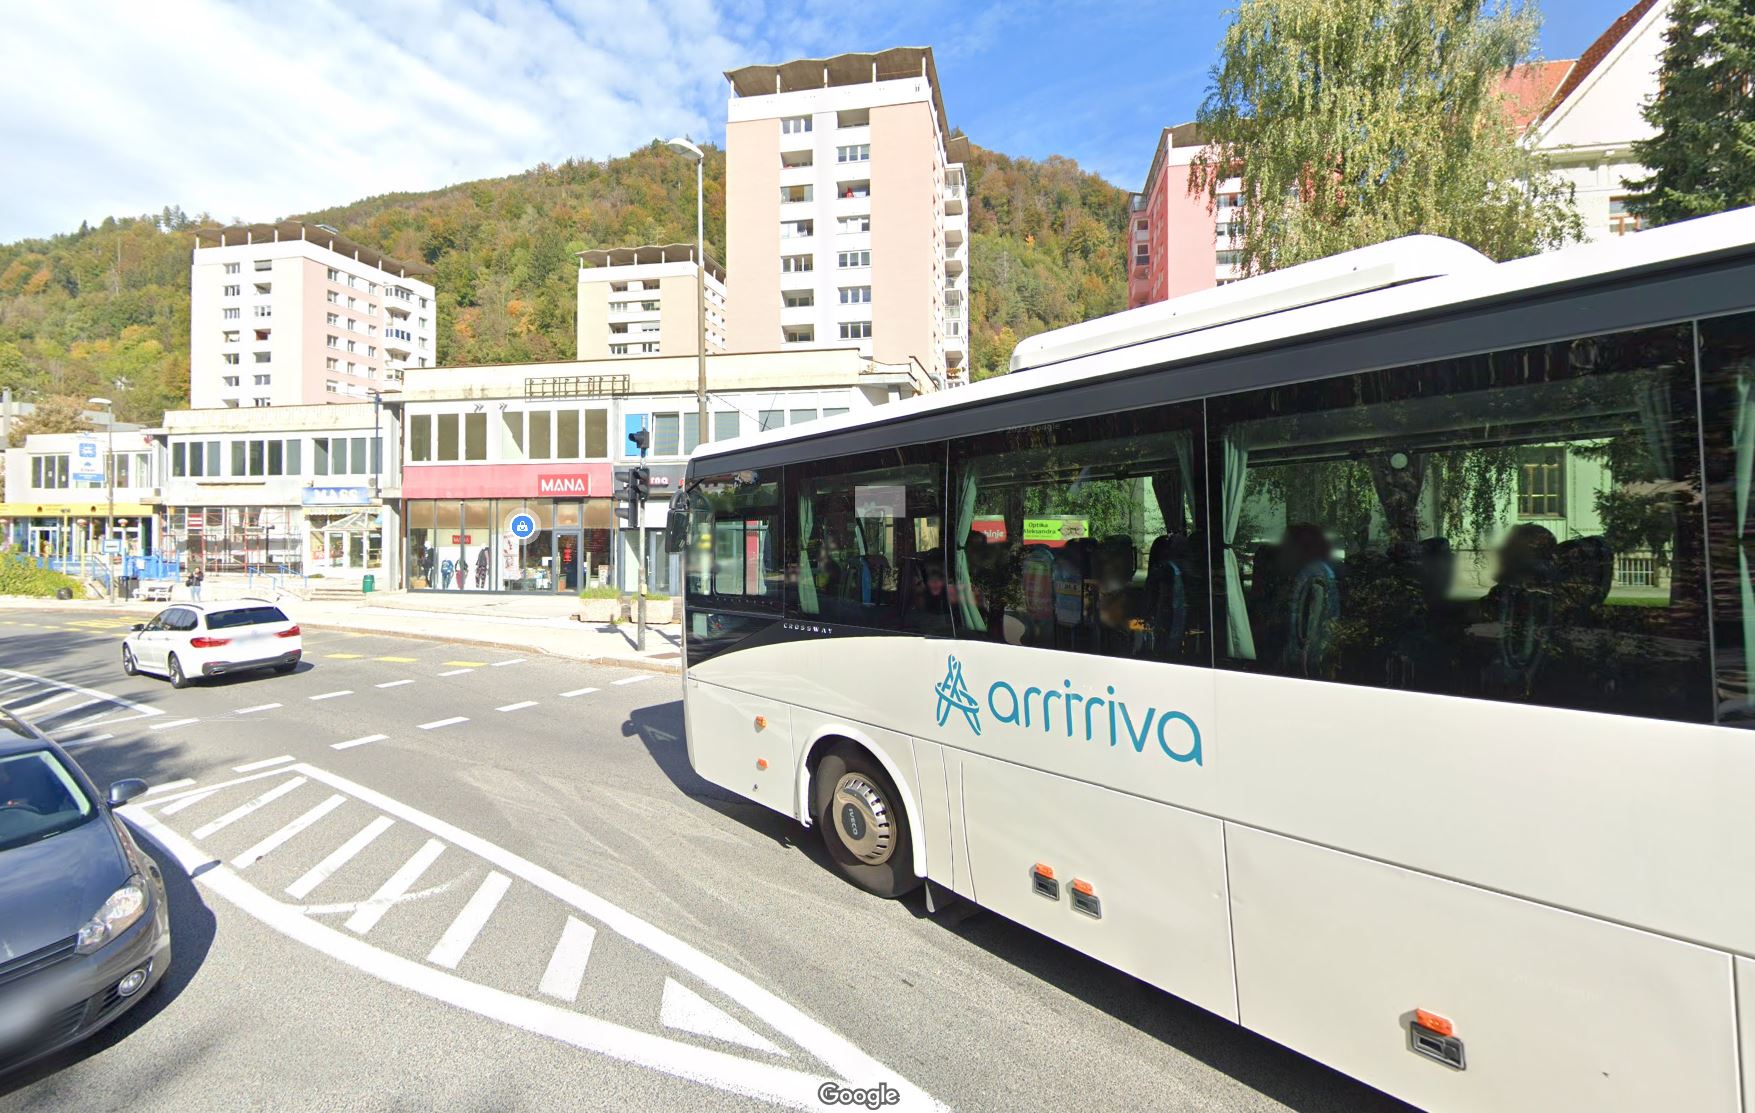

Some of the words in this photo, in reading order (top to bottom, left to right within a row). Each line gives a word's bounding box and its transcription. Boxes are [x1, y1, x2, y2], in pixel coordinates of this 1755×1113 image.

[541, 478, 586, 492] MANA
[983, 529, 1005, 539] hinje
[783, 622, 833, 634] CROSSWAY
[848, 808, 859, 836] IVECO
